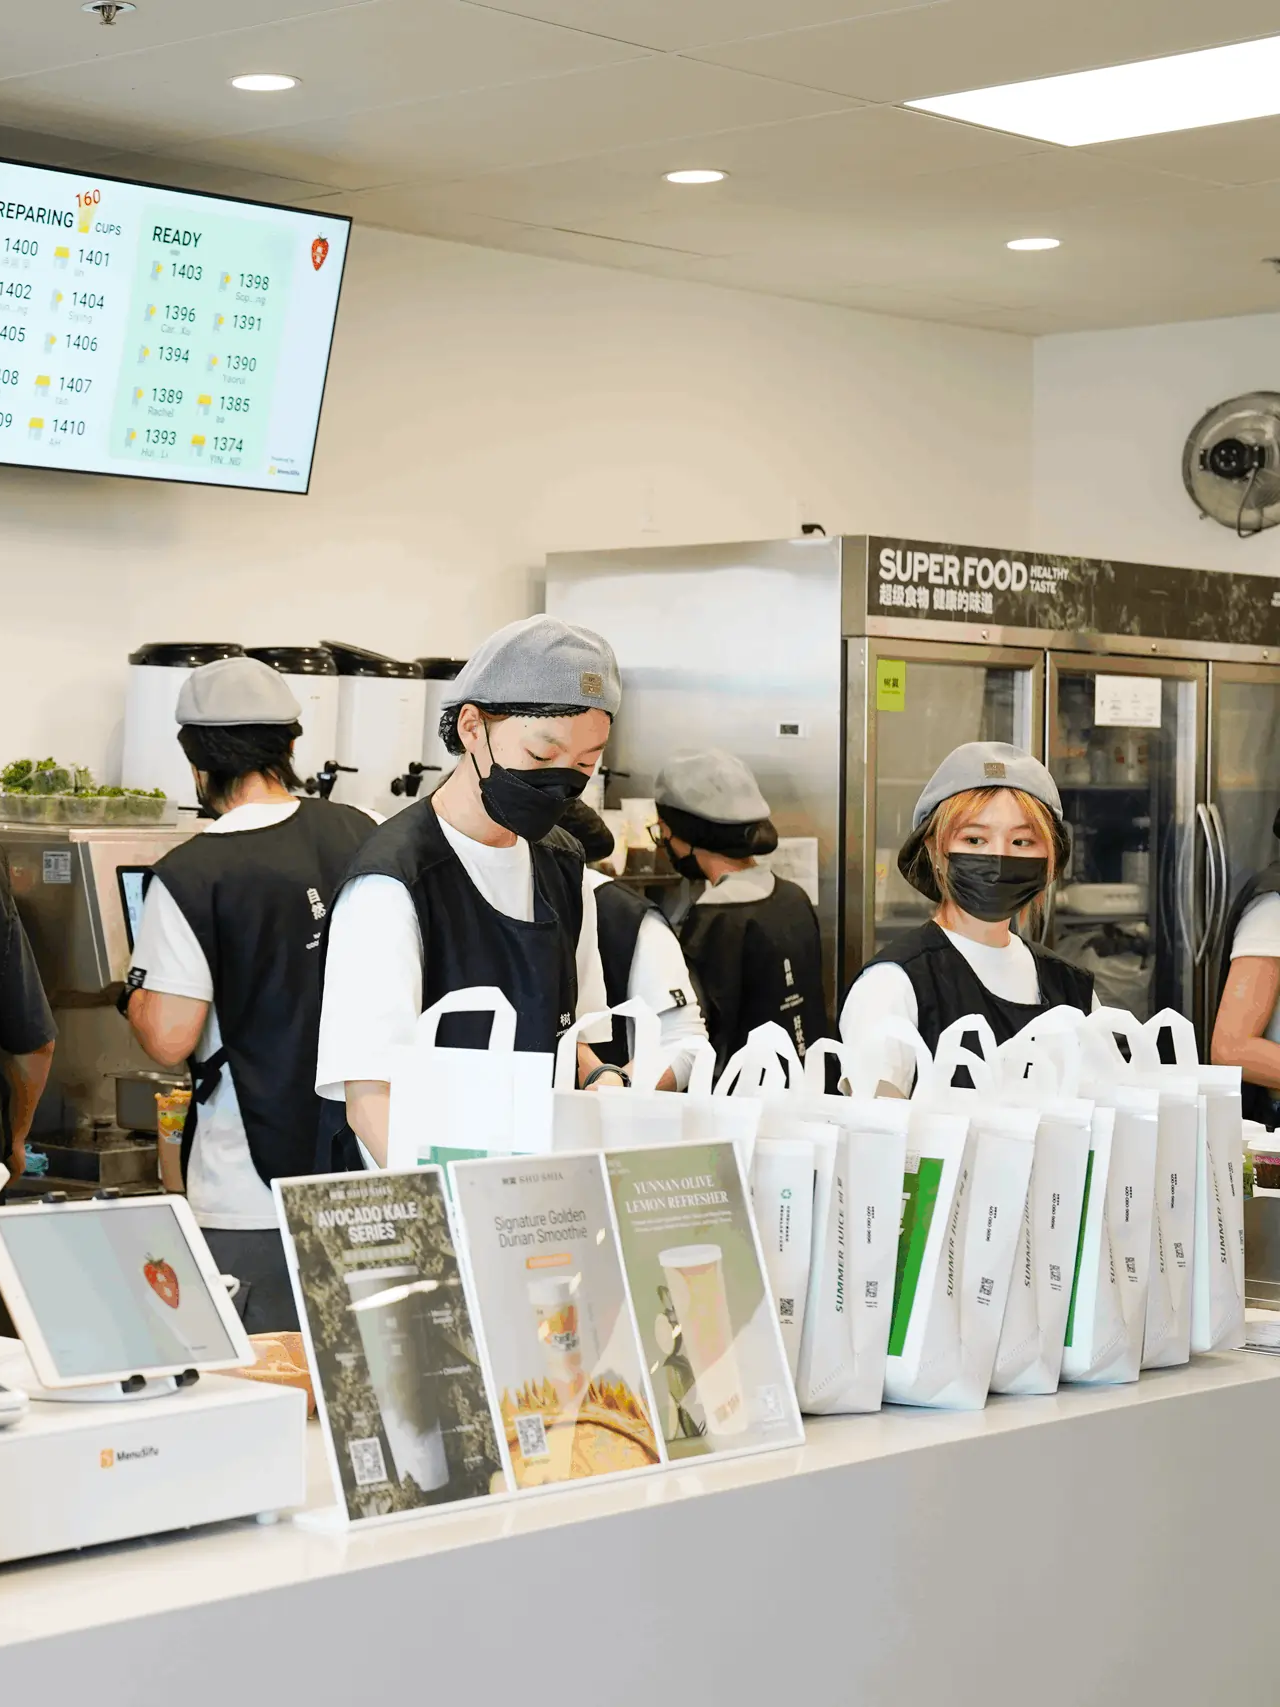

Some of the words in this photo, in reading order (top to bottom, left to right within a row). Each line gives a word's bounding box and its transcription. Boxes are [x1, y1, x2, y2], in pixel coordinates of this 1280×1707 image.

[75, 189, 101, 208] 160
[95, 222, 122, 236] CUPS
[152, 226, 202, 248] READY
[4, 237, 39, 257] 1400
[78, 249, 110, 267] 1401
[171, 263, 203, 281] 1403
[239, 273, 269, 291] 1398
[72, 291, 105, 310] 1404
[164, 305, 196, 323] 1396
[232, 315, 262, 332] 1391
[66, 334, 98, 351] 1406
[158, 346, 190, 363] 1394
[226, 355, 257, 372] 1390
[59, 376, 92, 394] 1407
[152, 388, 183, 405] 1389
[220, 396, 250, 413] 1385
[148, 406, 174, 418] Rachel
[53, 419, 86, 436] 1410
[145, 429, 177, 446] 1393
[213, 436, 244, 453] 1374
[879, 548, 960, 586] SUPER
[963, 556, 1028, 592] FOOD
[1030, 565, 1069, 581] HEALTHY
[1030, 580, 1057, 594] TASTE
[879, 583, 930, 610] 超级食物
[933, 587, 993, 614] 健康的味道
[633, 1179, 680, 1195] YUNNAN
[681, 1174, 715, 1190] OLIVE
[624, 1196, 666, 1214] LEMON
[667, 1190, 729, 1209] REFRESHER
[318, 1206, 382, 1228] AVOCADO
[383, 1202, 418, 1221] KALE
[494, 1214, 547, 1233] Signature
[548, 1208, 586, 1225] Golden
[348, 1222, 396, 1243] SERIES
[498, 1232, 535, 1248] Durian
[536, 1226, 588, 1243] Smoothie
[837, 1210, 845, 1246] JUICE
[1217, 1206, 1227, 1264] SUMMER
[946, 1237, 955, 1299] SUMMER
[951, 1200, 961, 1236] JUICE
[1024, 1228, 1032, 1289] SUMMER
[835, 1250, 845, 1313] SUMMER
